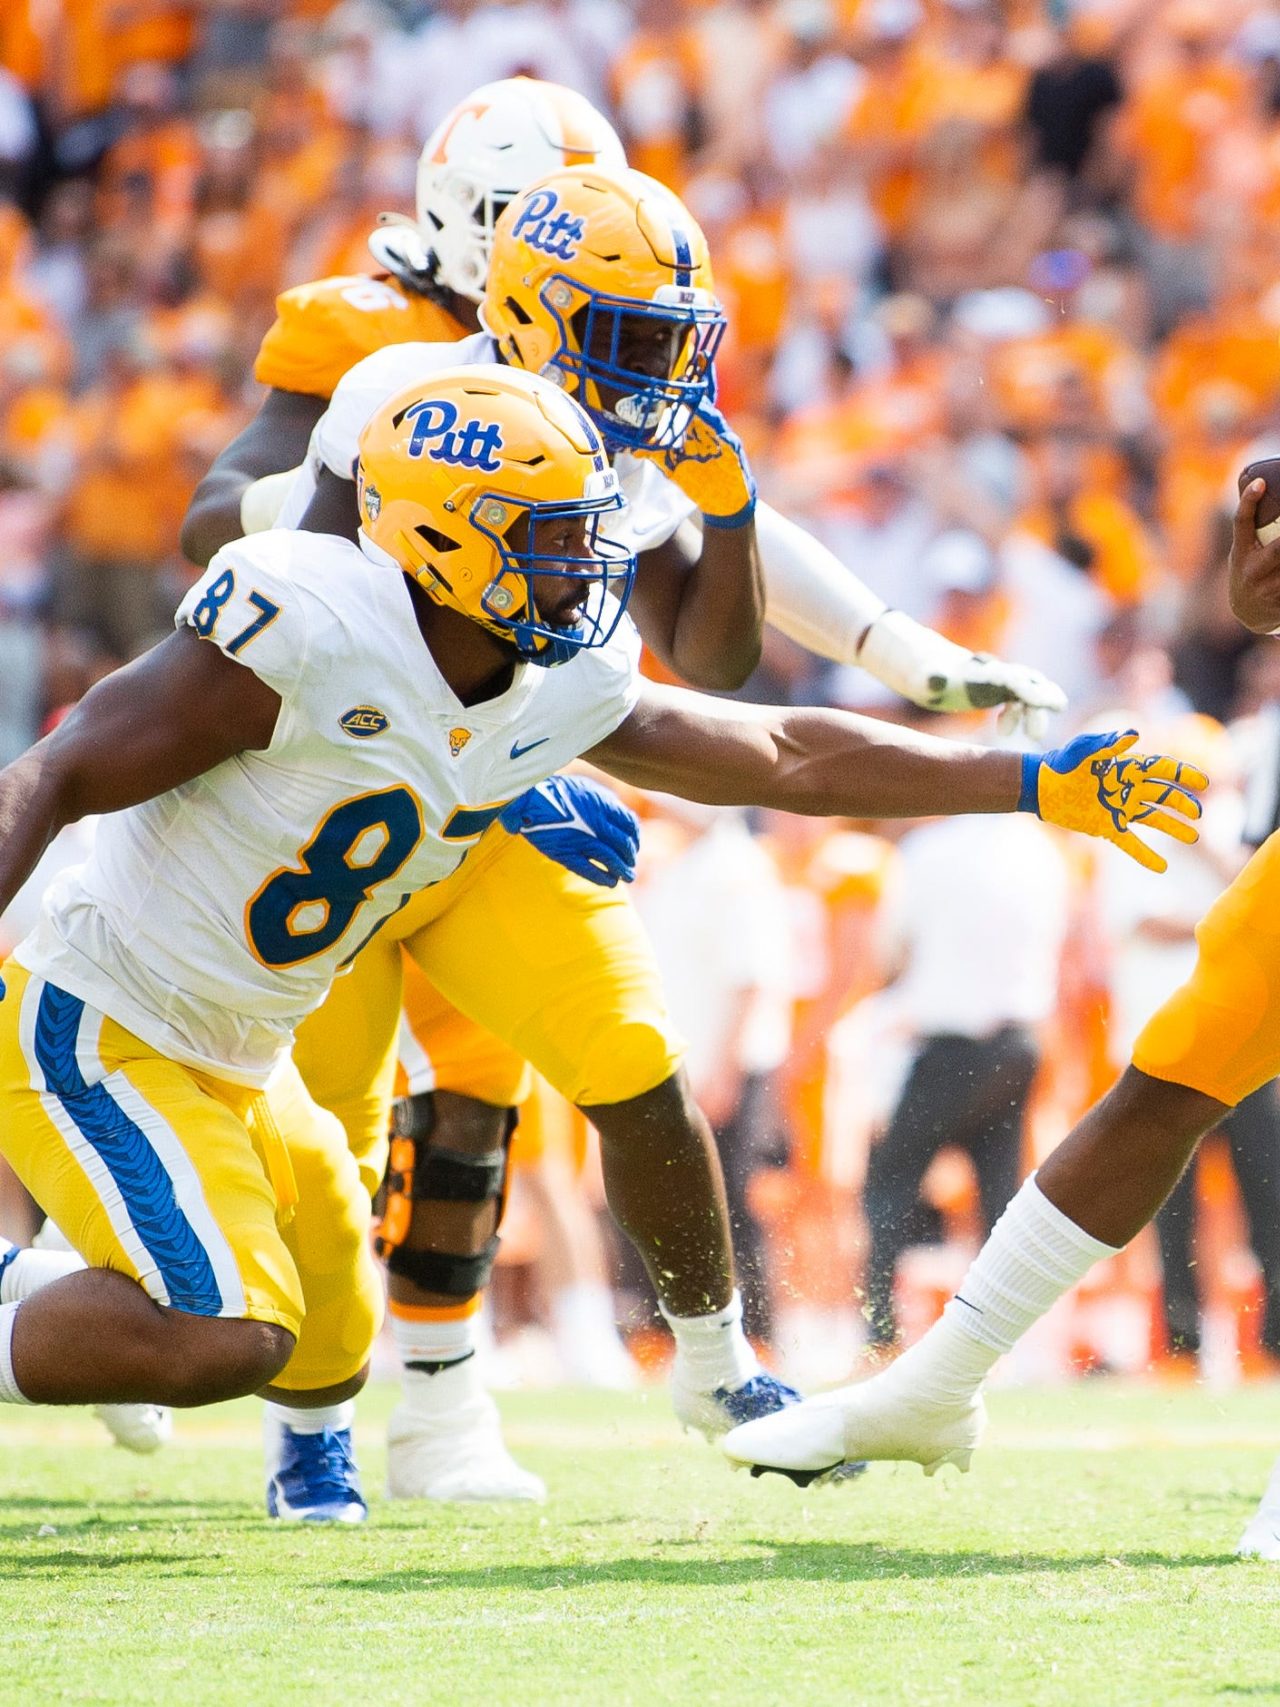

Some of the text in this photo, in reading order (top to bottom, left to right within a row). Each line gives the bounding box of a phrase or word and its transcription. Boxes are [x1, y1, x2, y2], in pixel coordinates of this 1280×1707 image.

[511, 189, 584, 262] Pitt
[406, 400, 503, 472] Pitt
[192, 567, 281, 657] 87
[346, 713, 385, 729] ACC
